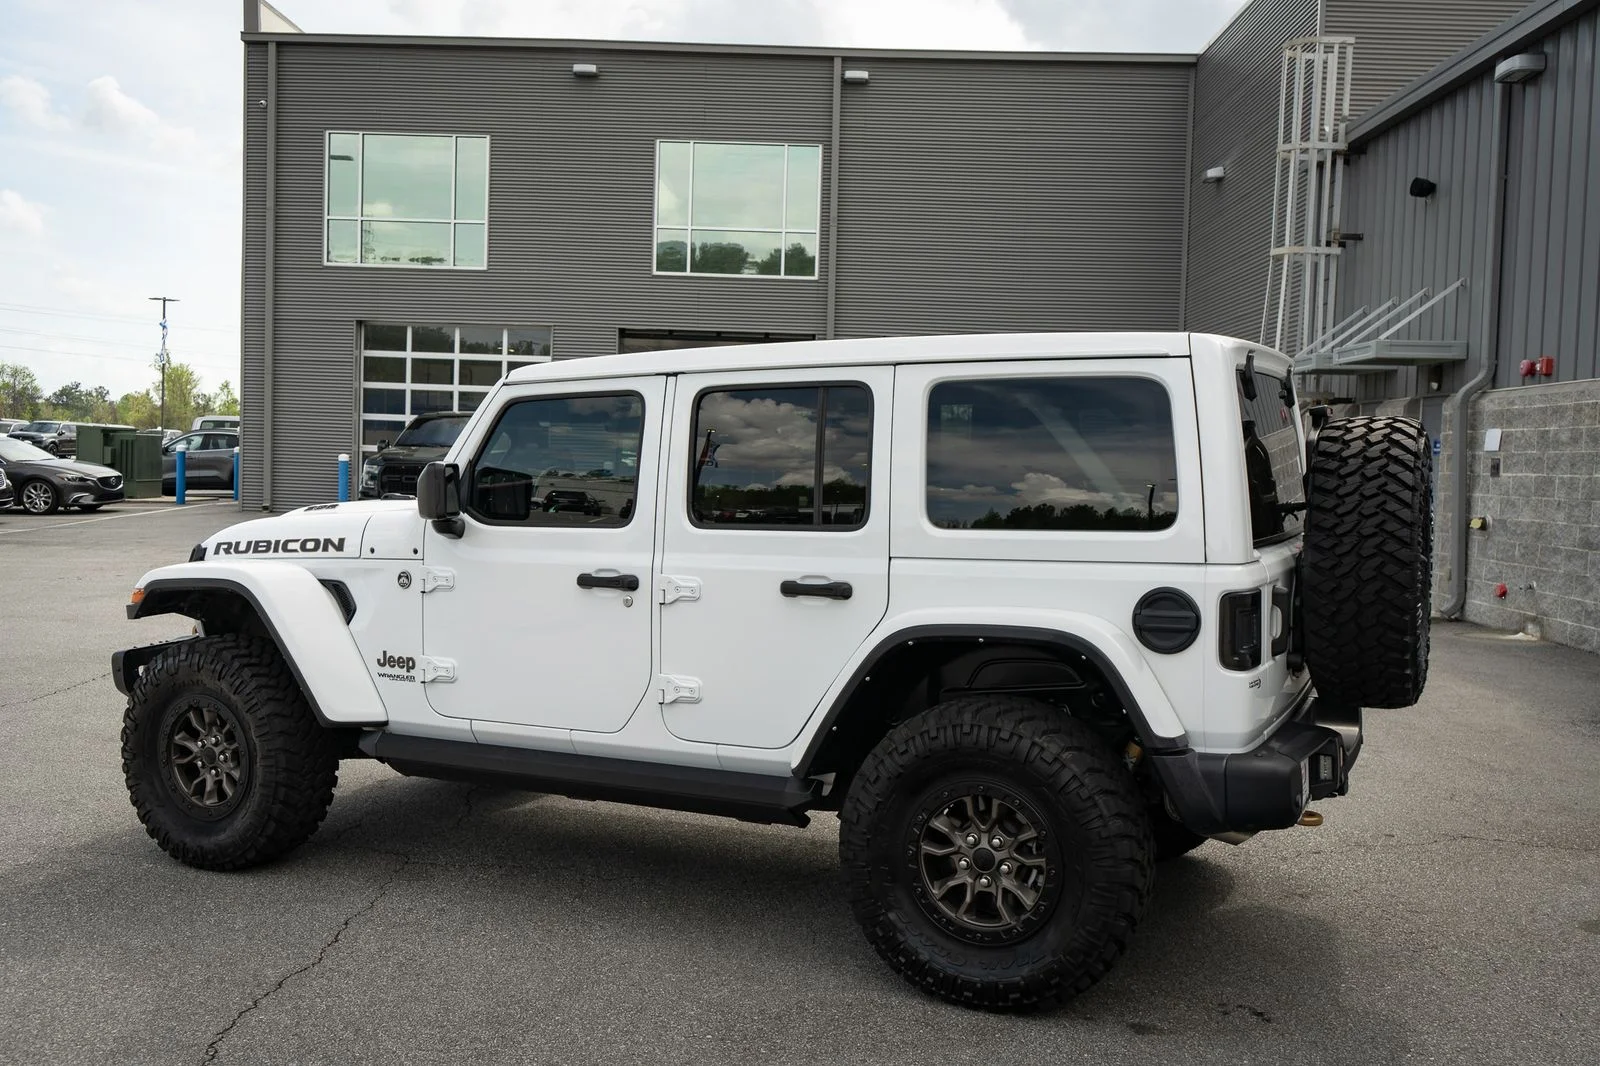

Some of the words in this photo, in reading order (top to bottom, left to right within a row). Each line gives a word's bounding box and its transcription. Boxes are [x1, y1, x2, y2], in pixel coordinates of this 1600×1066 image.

[213, 537, 346, 556] RUBICON
[376, 650, 416, 673] Jeep
[377, 672, 416, 680] WRANGLER
